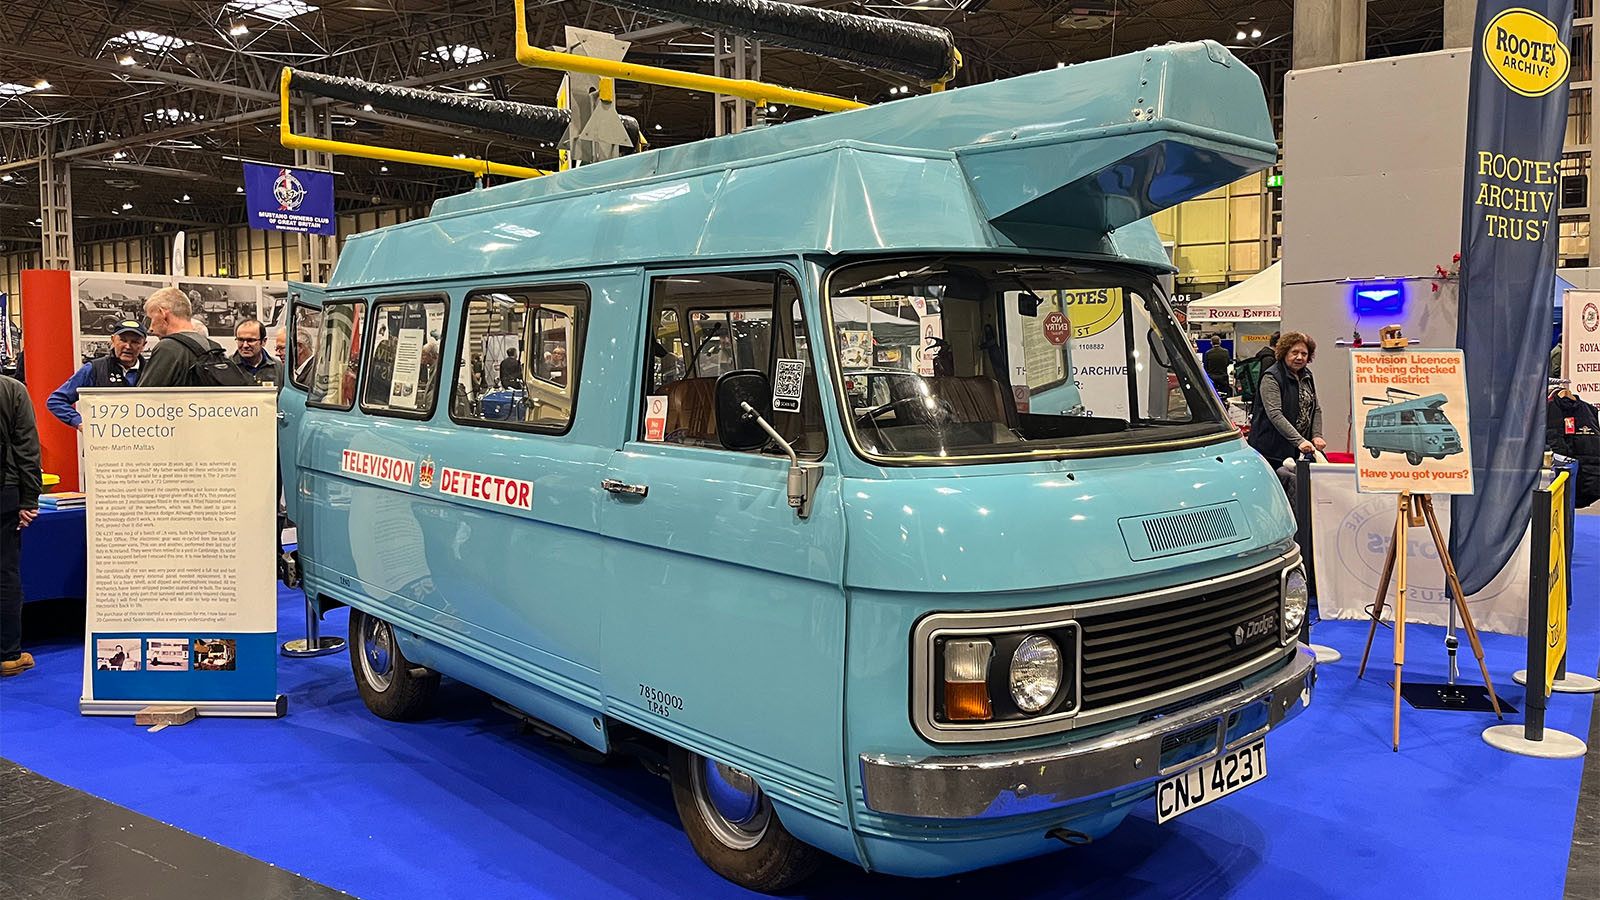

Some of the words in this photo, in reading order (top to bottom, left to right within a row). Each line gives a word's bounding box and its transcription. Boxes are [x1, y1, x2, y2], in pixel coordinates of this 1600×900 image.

[1496, 26, 1556, 67] ROOTES
[1503, 55, 1549, 79] ARCHIVE
[1475, 183, 1554, 213] ARCHIV
[258, 211, 288, 220] MUSTANG
[289, 214, 314, 222] OWNERS
[1209, 308, 1240, 319] ROYAL
[1242, 309, 1281, 319] ENFIEL
[1580, 343, 1600, 352] ROYA
[1354, 354, 1407, 364] Television
[1411, 355, 1460, 365] Licences
[1081, 366, 1128, 376] ARCHIVE
[1356, 366, 1373, 374] are
[1376, 365, 1407, 376] being
[1409, 365, 1456, 374] checked
[1577, 363, 1600, 372] ENFIE
[1357, 375, 1367, 383] in
[1370, 374, 1389, 383] this
[1391, 374, 1430, 384] district
[1577, 383, 1600, 392] OWNE
[91, 404, 129, 418] 1979
[135, 403, 184, 420] Dodge
[188, 403, 259, 419] Spacevan
[90, 424, 105, 438] TV
[111, 424, 175, 438] Detector
[343, 451, 414, 484] TELEVISION
[441, 470, 530, 507] DETECTOR
[1360, 468, 1388, 478] Have
[1390, 471, 1409, 480] you
[1412, 470, 1430, 480] got
[1432, 469, 1469, 480] yours?
[1246, 615, 1273, 638] Dodge
[639, 683, 684, 711] 7850002
[1157, 773, 1206, 818] CNJ
[1211, 741, 1266, 793] 423T
